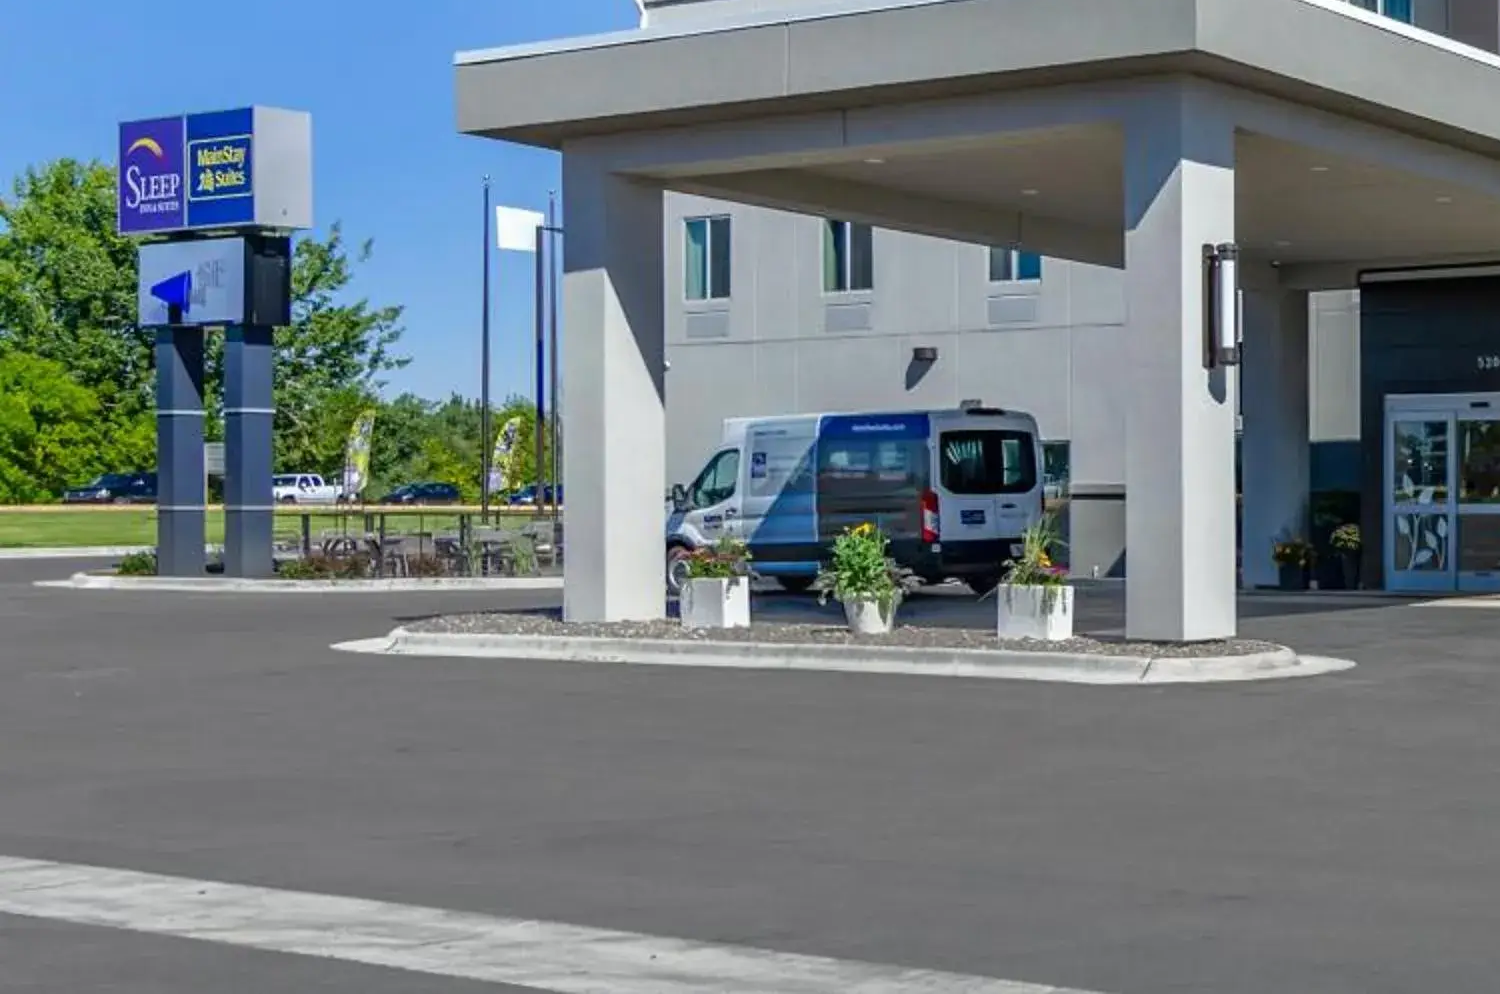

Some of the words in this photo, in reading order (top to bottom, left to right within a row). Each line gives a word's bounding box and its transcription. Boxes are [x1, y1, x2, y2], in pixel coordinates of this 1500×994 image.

[197, 145, 246, 169] MainStay
[125, 165, 180, 209] SLEEP
[215, 167, 246, 187] Suites
